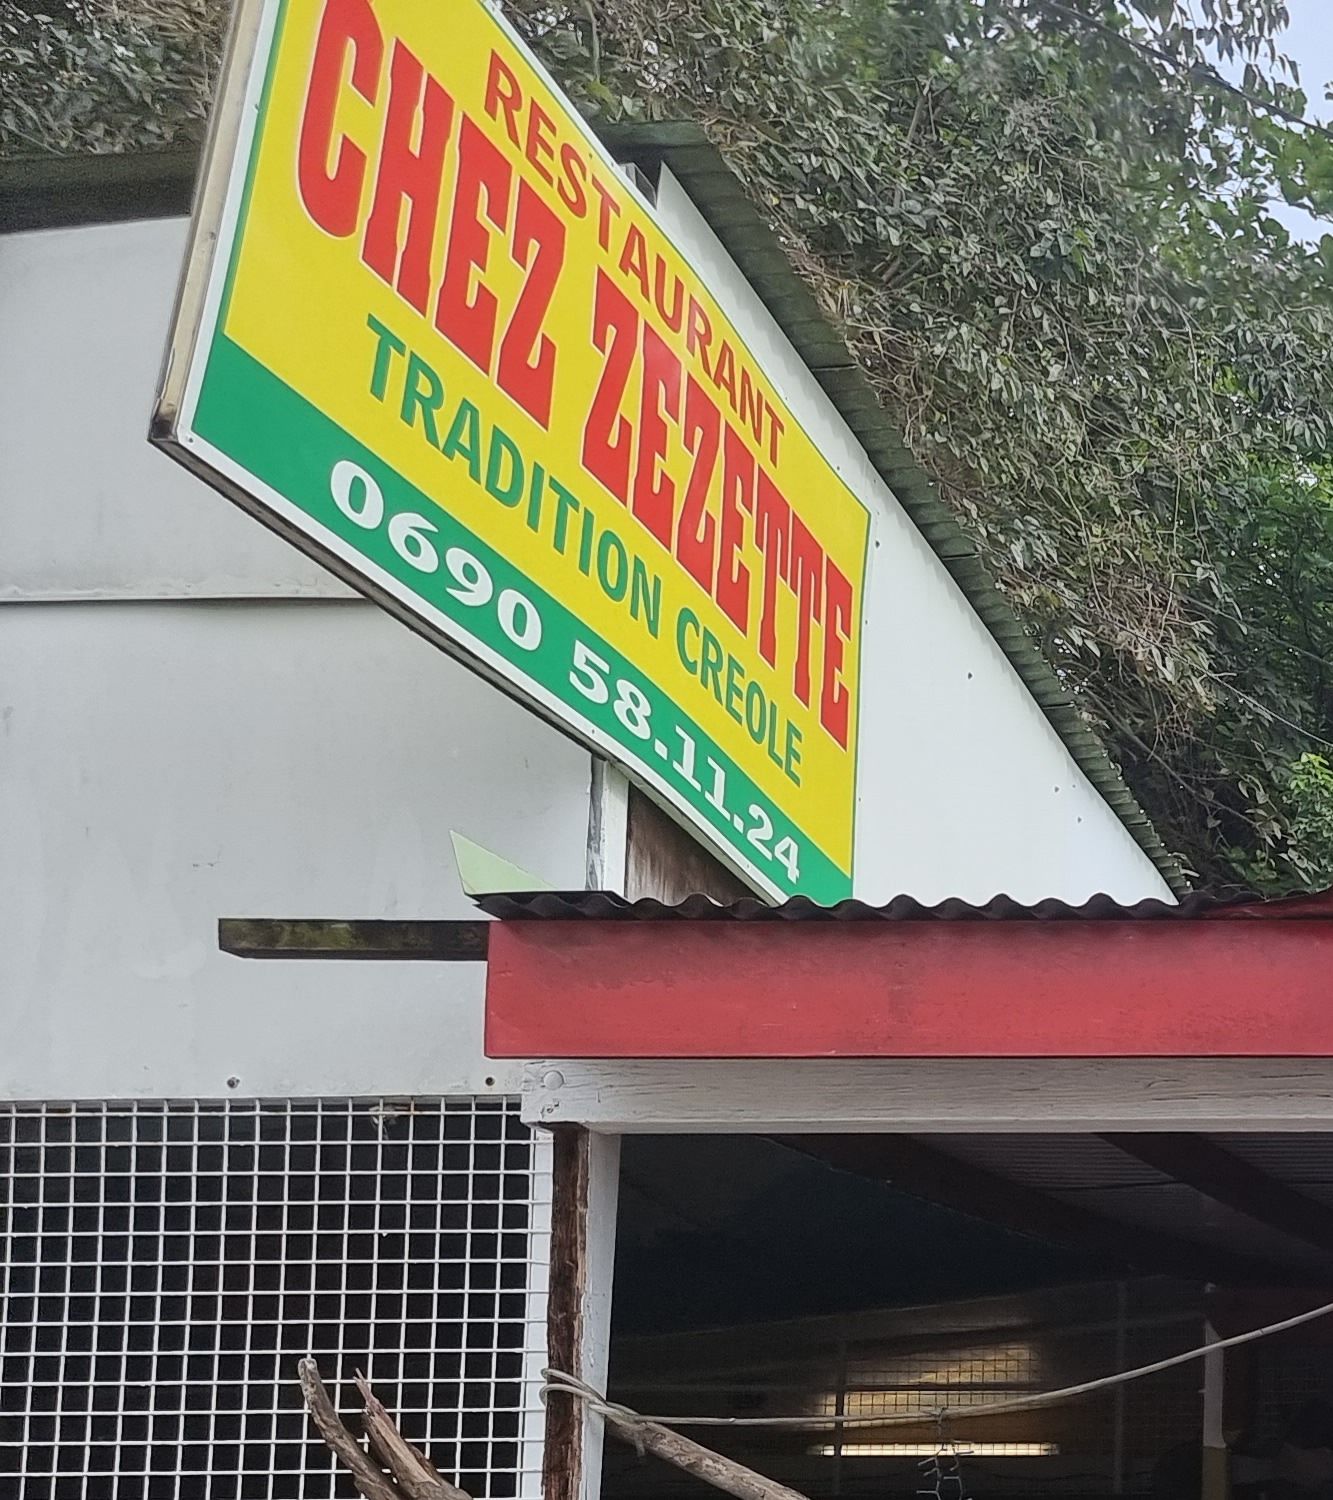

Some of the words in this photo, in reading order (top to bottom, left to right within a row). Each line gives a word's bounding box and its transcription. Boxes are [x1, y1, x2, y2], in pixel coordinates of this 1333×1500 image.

[297, 0, 567, 431] CHEZ
[581, 265, 855, 752] ZEZETTE
[483, 48, 786, 469] RESTAURANT
[329, 459, 543, 651] 0690
[569, 646, 800, 885] 58.11.24
[366, 313, 663, 639] TRADITION
[676, 607, 802, 788] CREOLE
